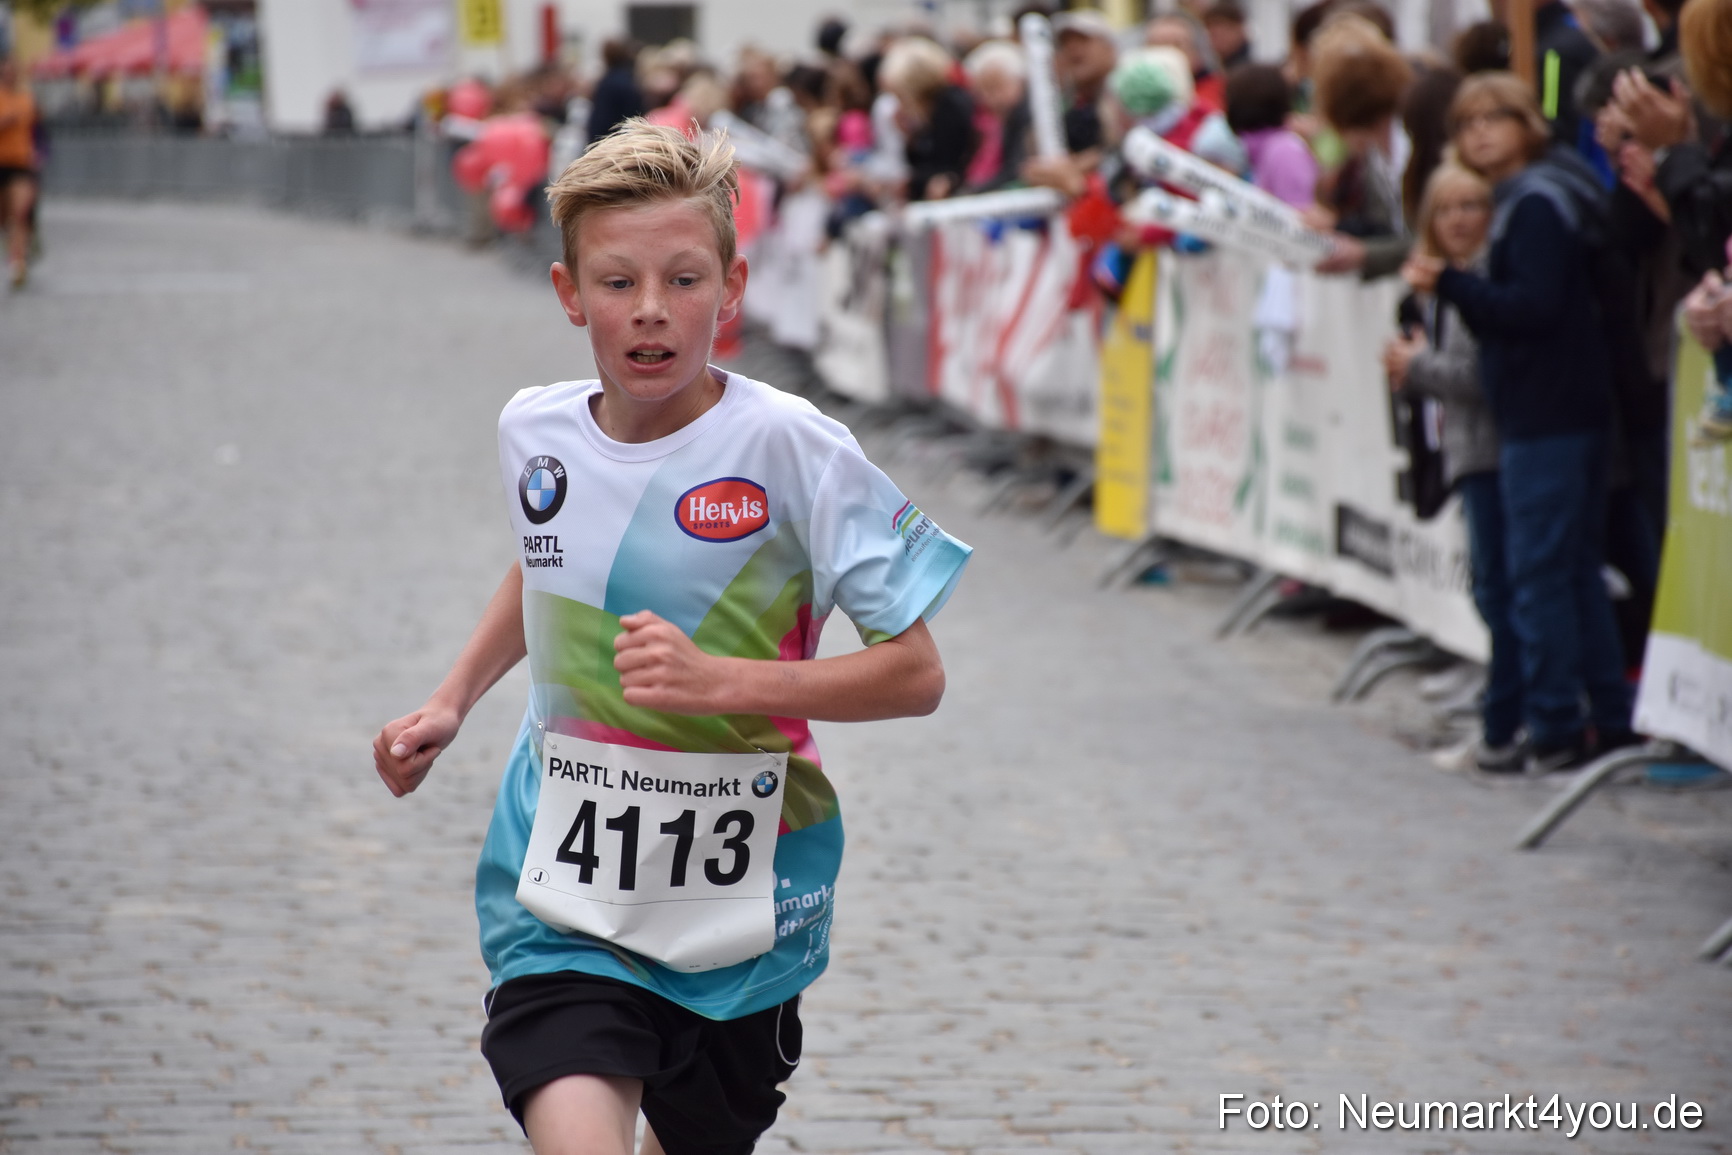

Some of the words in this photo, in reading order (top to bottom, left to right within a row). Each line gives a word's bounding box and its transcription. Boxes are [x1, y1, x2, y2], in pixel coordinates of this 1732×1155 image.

[524, 457, 565, 479] BMW
[689, 496, 763, 524] Hervis
[693, 522, 730, 530] SPORTS
[523, 535, 563, 553] PARTL
[525, 555, 563, 567] Neumarkt
[549, 756, 613, 789] PARTL
[621, 770, 741, 797] Neumarkt
[555, 799, 755, 891] 4113
[534, 871, 543, 882] J
